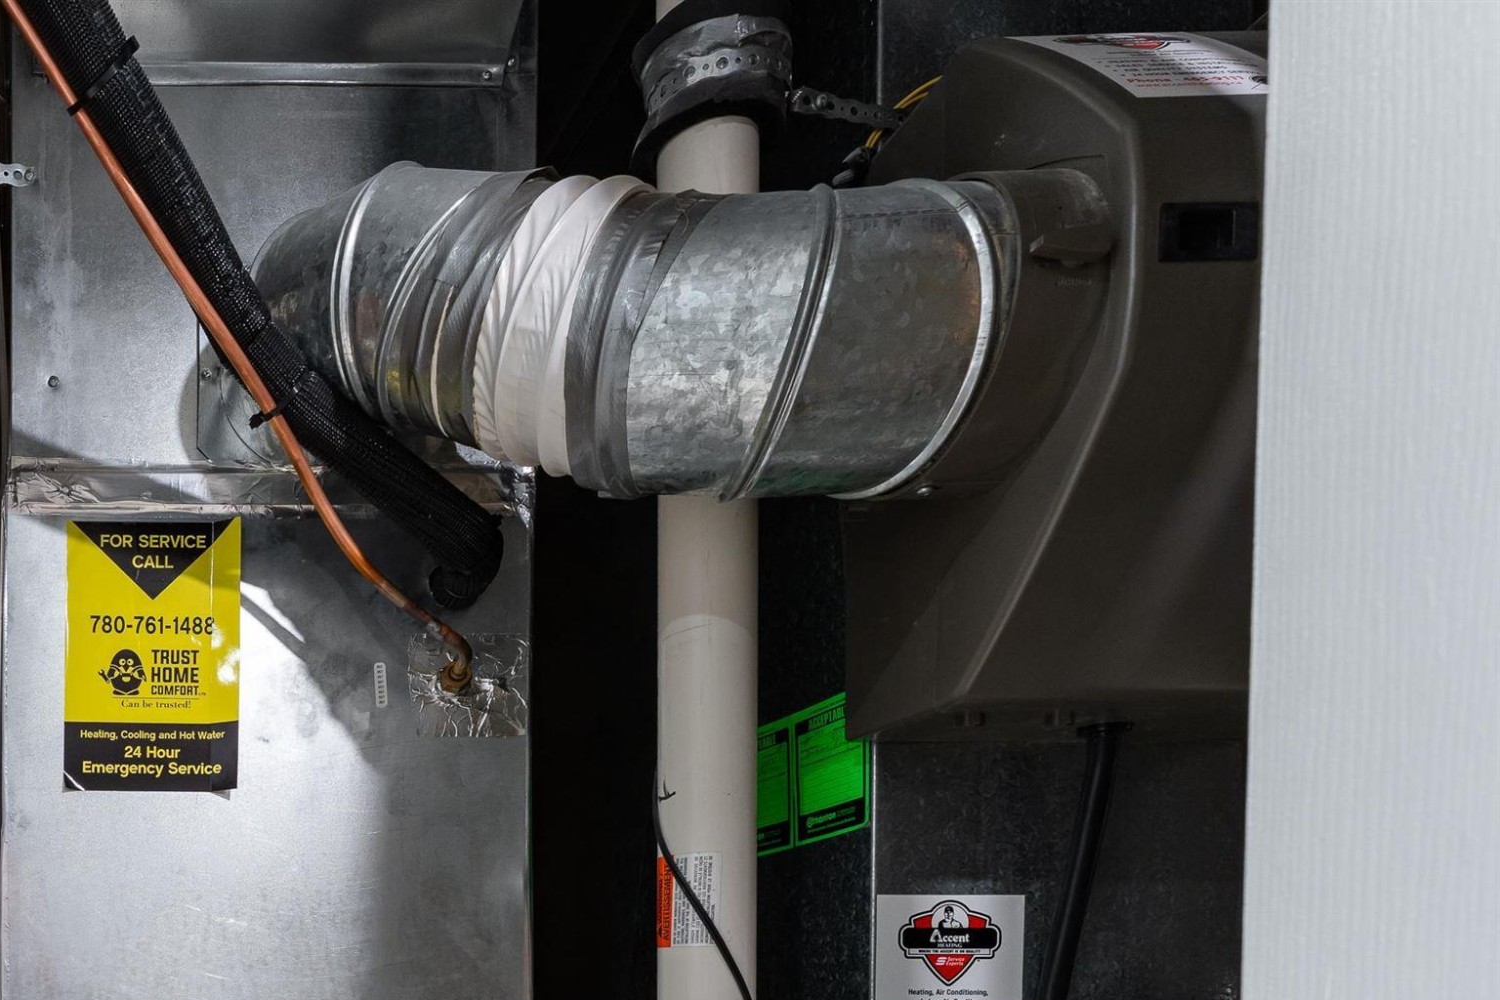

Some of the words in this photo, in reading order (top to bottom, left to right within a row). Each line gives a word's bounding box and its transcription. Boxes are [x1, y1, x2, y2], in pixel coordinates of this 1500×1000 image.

[100, 535, 133, 548] FOR
[138, 534, 206, 548] SERVICE
[132, 555, 174, 569] CALL
[90, 615, 215, 635] 780-761-1488
[151, 649, 199, 665] TRUST
[151, 667, 199, 683] HOME
[151, 685, 198, 696] COMFORT
[120, 699, 140, 709] Can
[142, 699, 153, 709] be
[155, 699, 192, 709] trusted!
[808, 705, 846, 731] ACCEPTABL
[80, 729, 118, 741] Heating,
[120, 729, 156, 742] Cooling
[158, 730, 177, 740] and
[179, 730, 195, 740] Hot
[197, 729, 225, 740] Water
[124, 746, 142, 758] 24
[146, 746, 180, 758] Hour
[82, 761, 166, 778] Emergency
[168, 761, 222, 776] Service
[929, 928, 970, 943] Accent
[908, 988, 934, 997] Heating,
[935, 988, 945, 996] Air
[946, 988, 988, 997] Conditioning,
